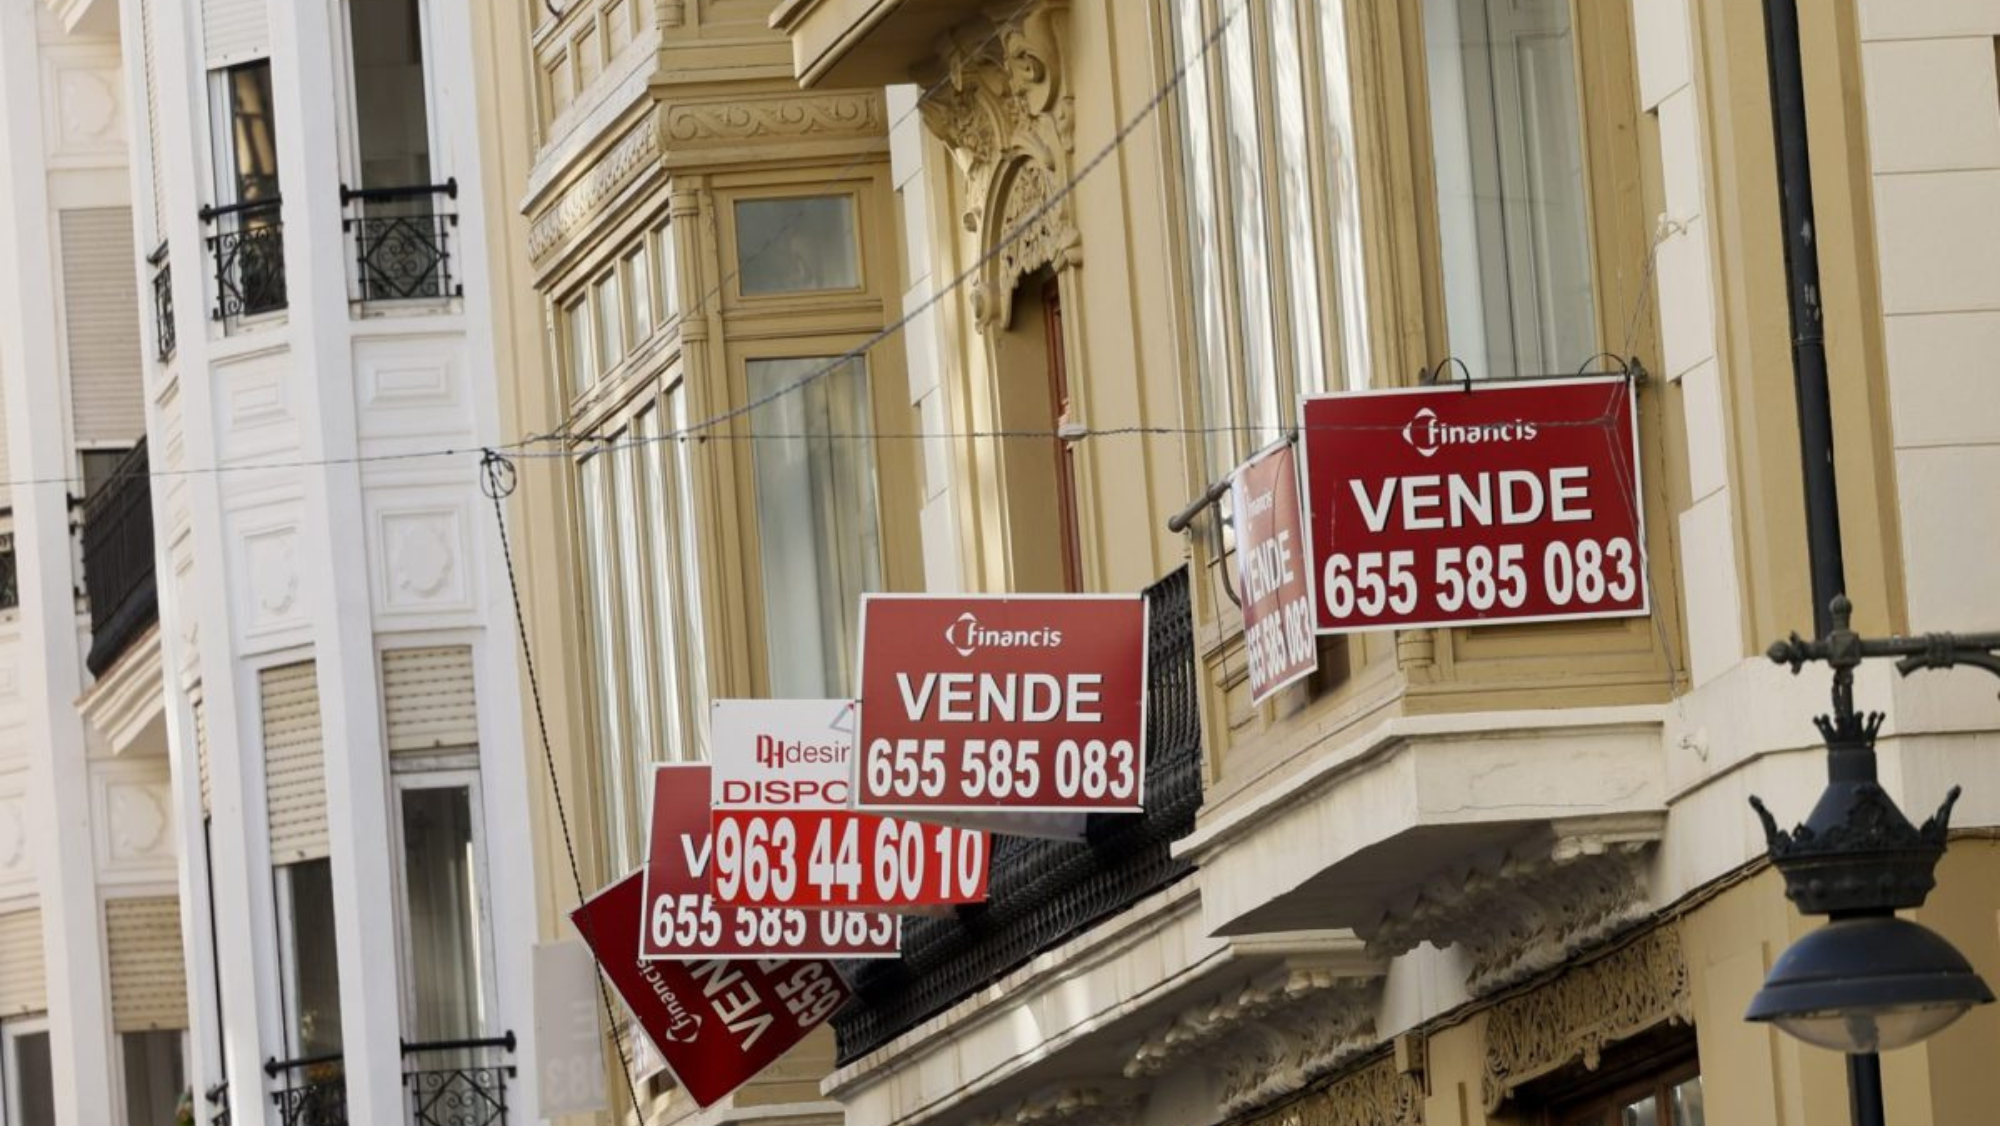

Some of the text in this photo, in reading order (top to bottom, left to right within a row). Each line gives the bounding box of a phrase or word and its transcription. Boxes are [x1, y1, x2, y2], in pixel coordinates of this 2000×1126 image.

[1428, 417, 1538, 446] financis
[1349, 466, 1593, 534] VENDE
[1323, 536, 1636, 618] 655 585 083
[967, 622, 1062, 648] financis
[1284, 595, 1314, 667] 083
[896, 672, 1103, 723] VENDE
[867, 738, 1134, 799] 655 585 083
[716, 816, 798, 901] 963
[808, 817, 863, 901] 44
[874, 816, 925, 900] 60
[935, 827, 983, 899] 10
[652, 894, 723, 948] 655
[734, 906, 807, 947] 585
[682, 959, 774, 1052] VEN
[774, 961, 841, 1027] 655
